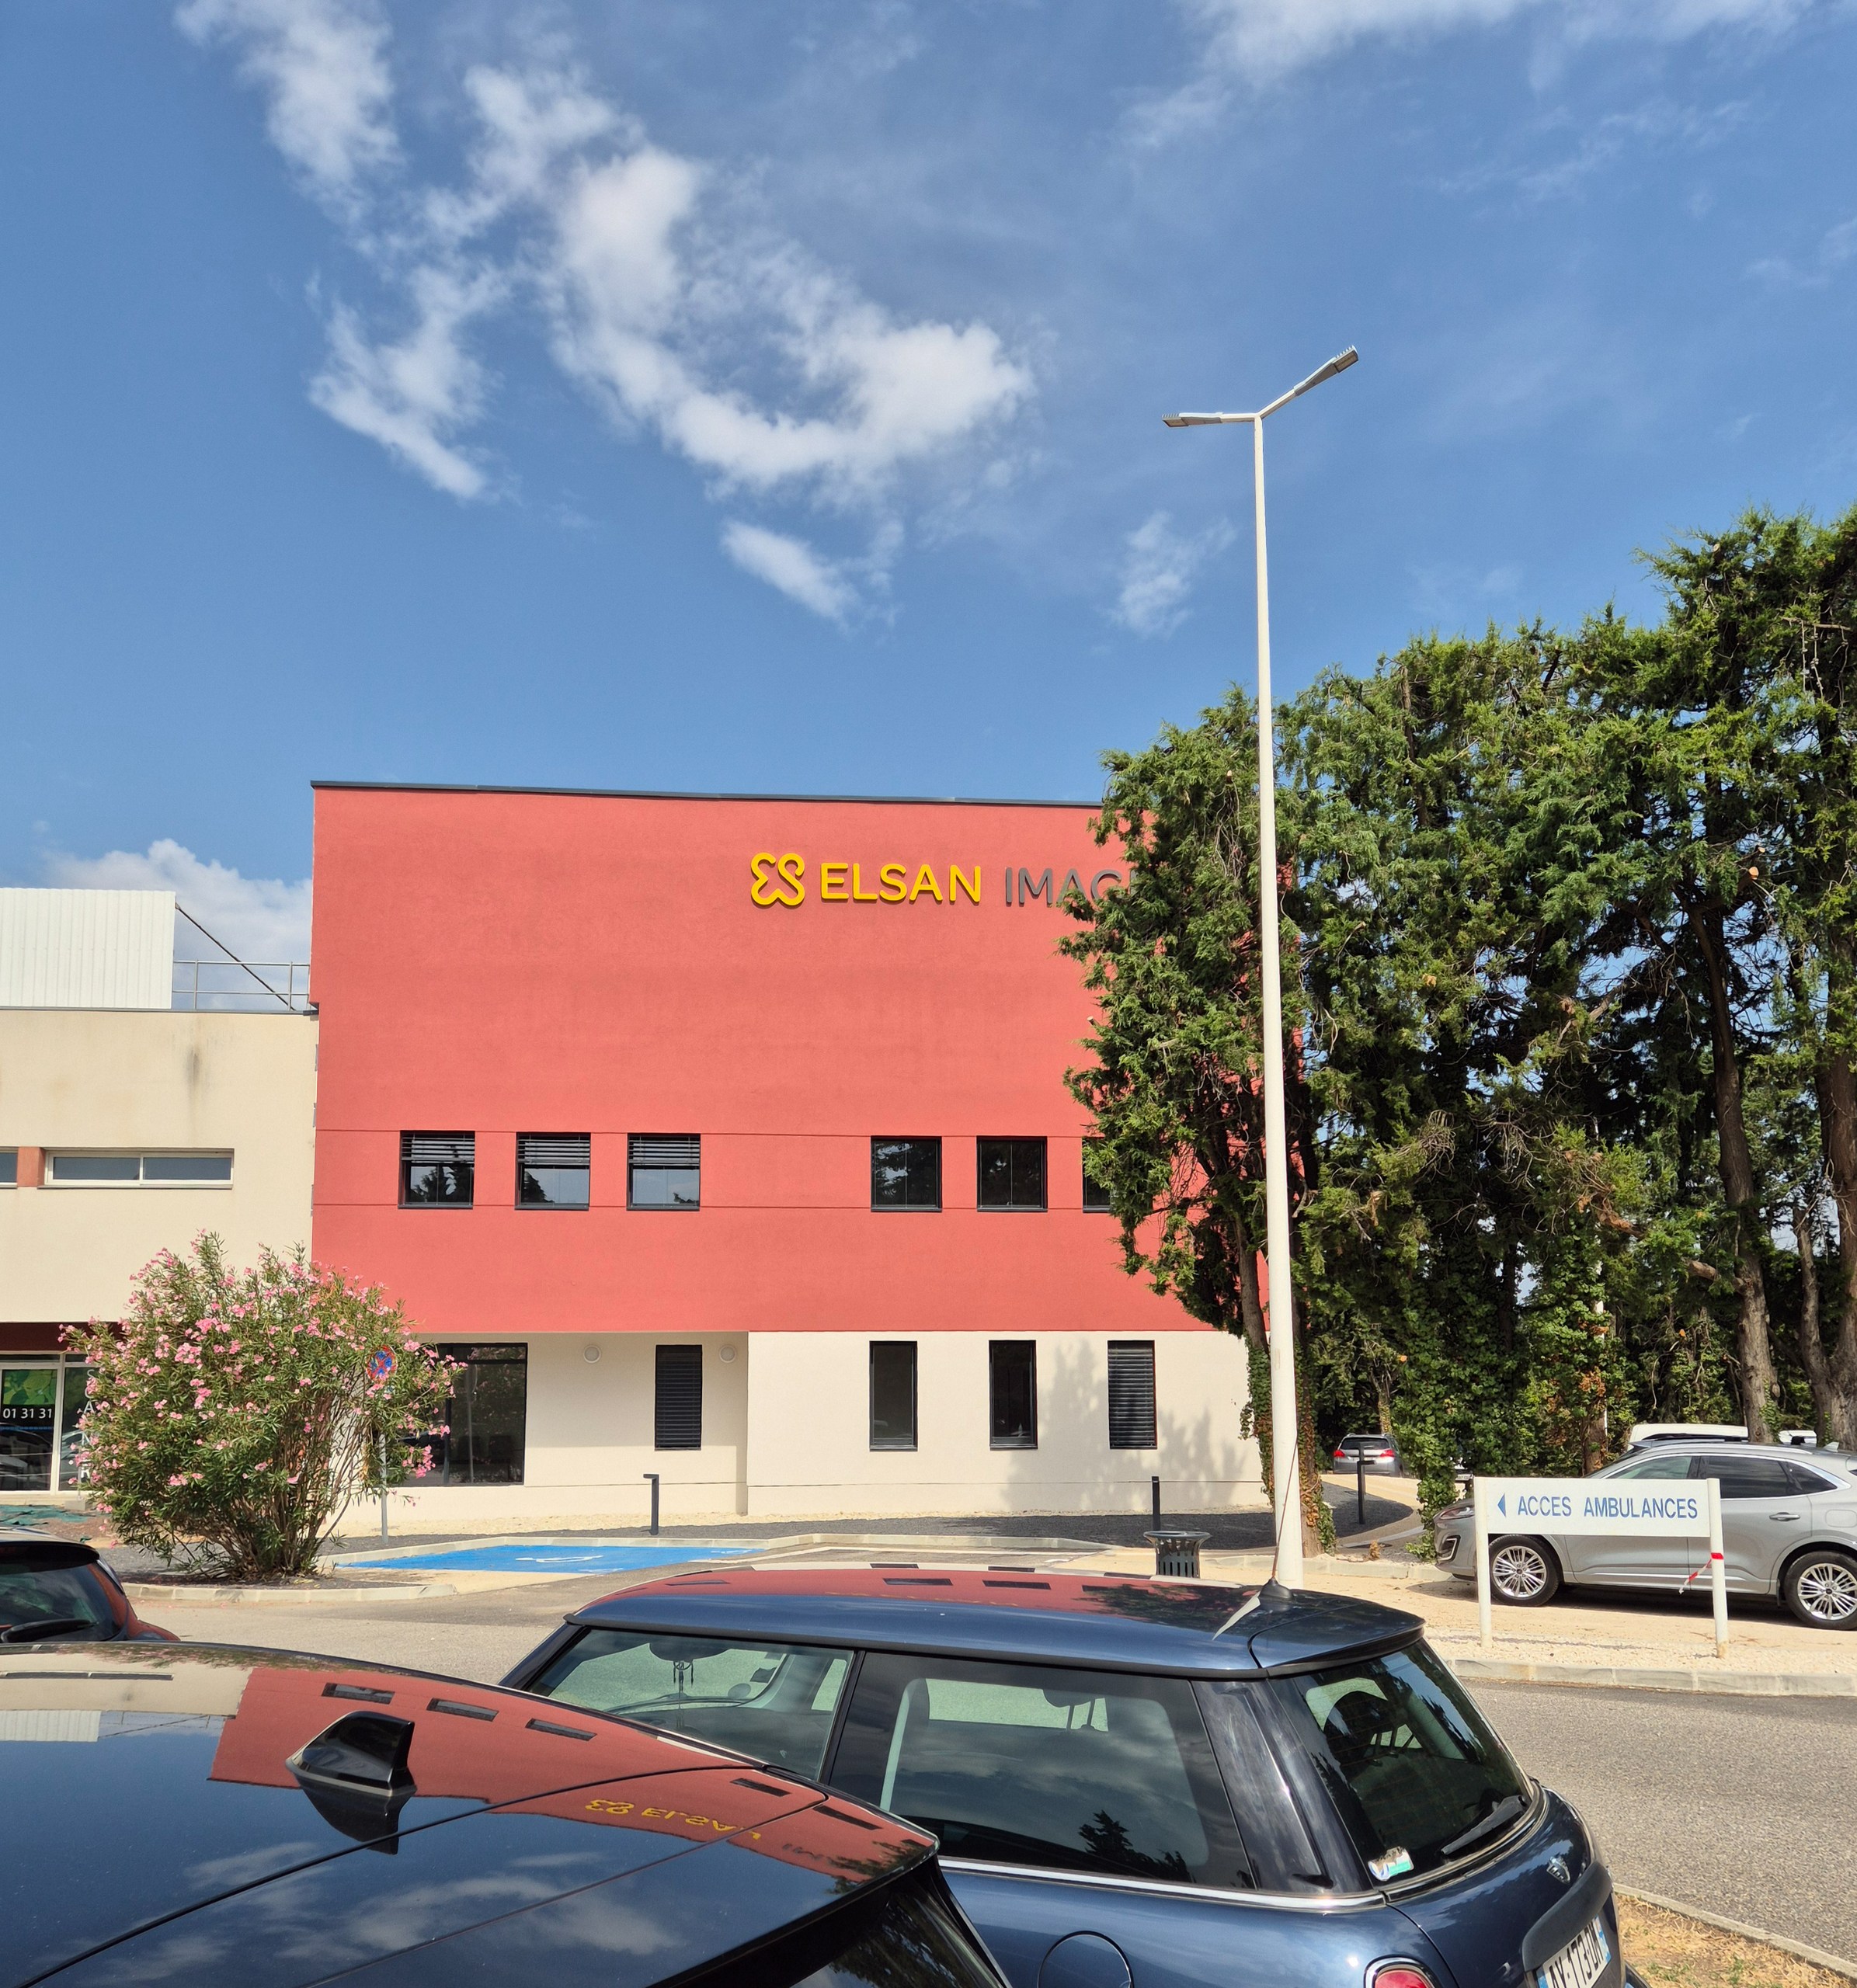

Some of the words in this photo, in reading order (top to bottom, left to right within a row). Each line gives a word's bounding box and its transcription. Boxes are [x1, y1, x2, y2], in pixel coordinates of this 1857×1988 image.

[820, 862, 982, 904] ELSAN
[1005, 866, 1137, 905] IMAG
[2, 1407, 16, 1419] 01
[20, 1407, 34, 1419] 31
[38, 1407, 52, 1419] 31
[1517, 1495, 1572, 1517] ACCES
[1584, 1496, 1699, 1520] AMBULANCES
